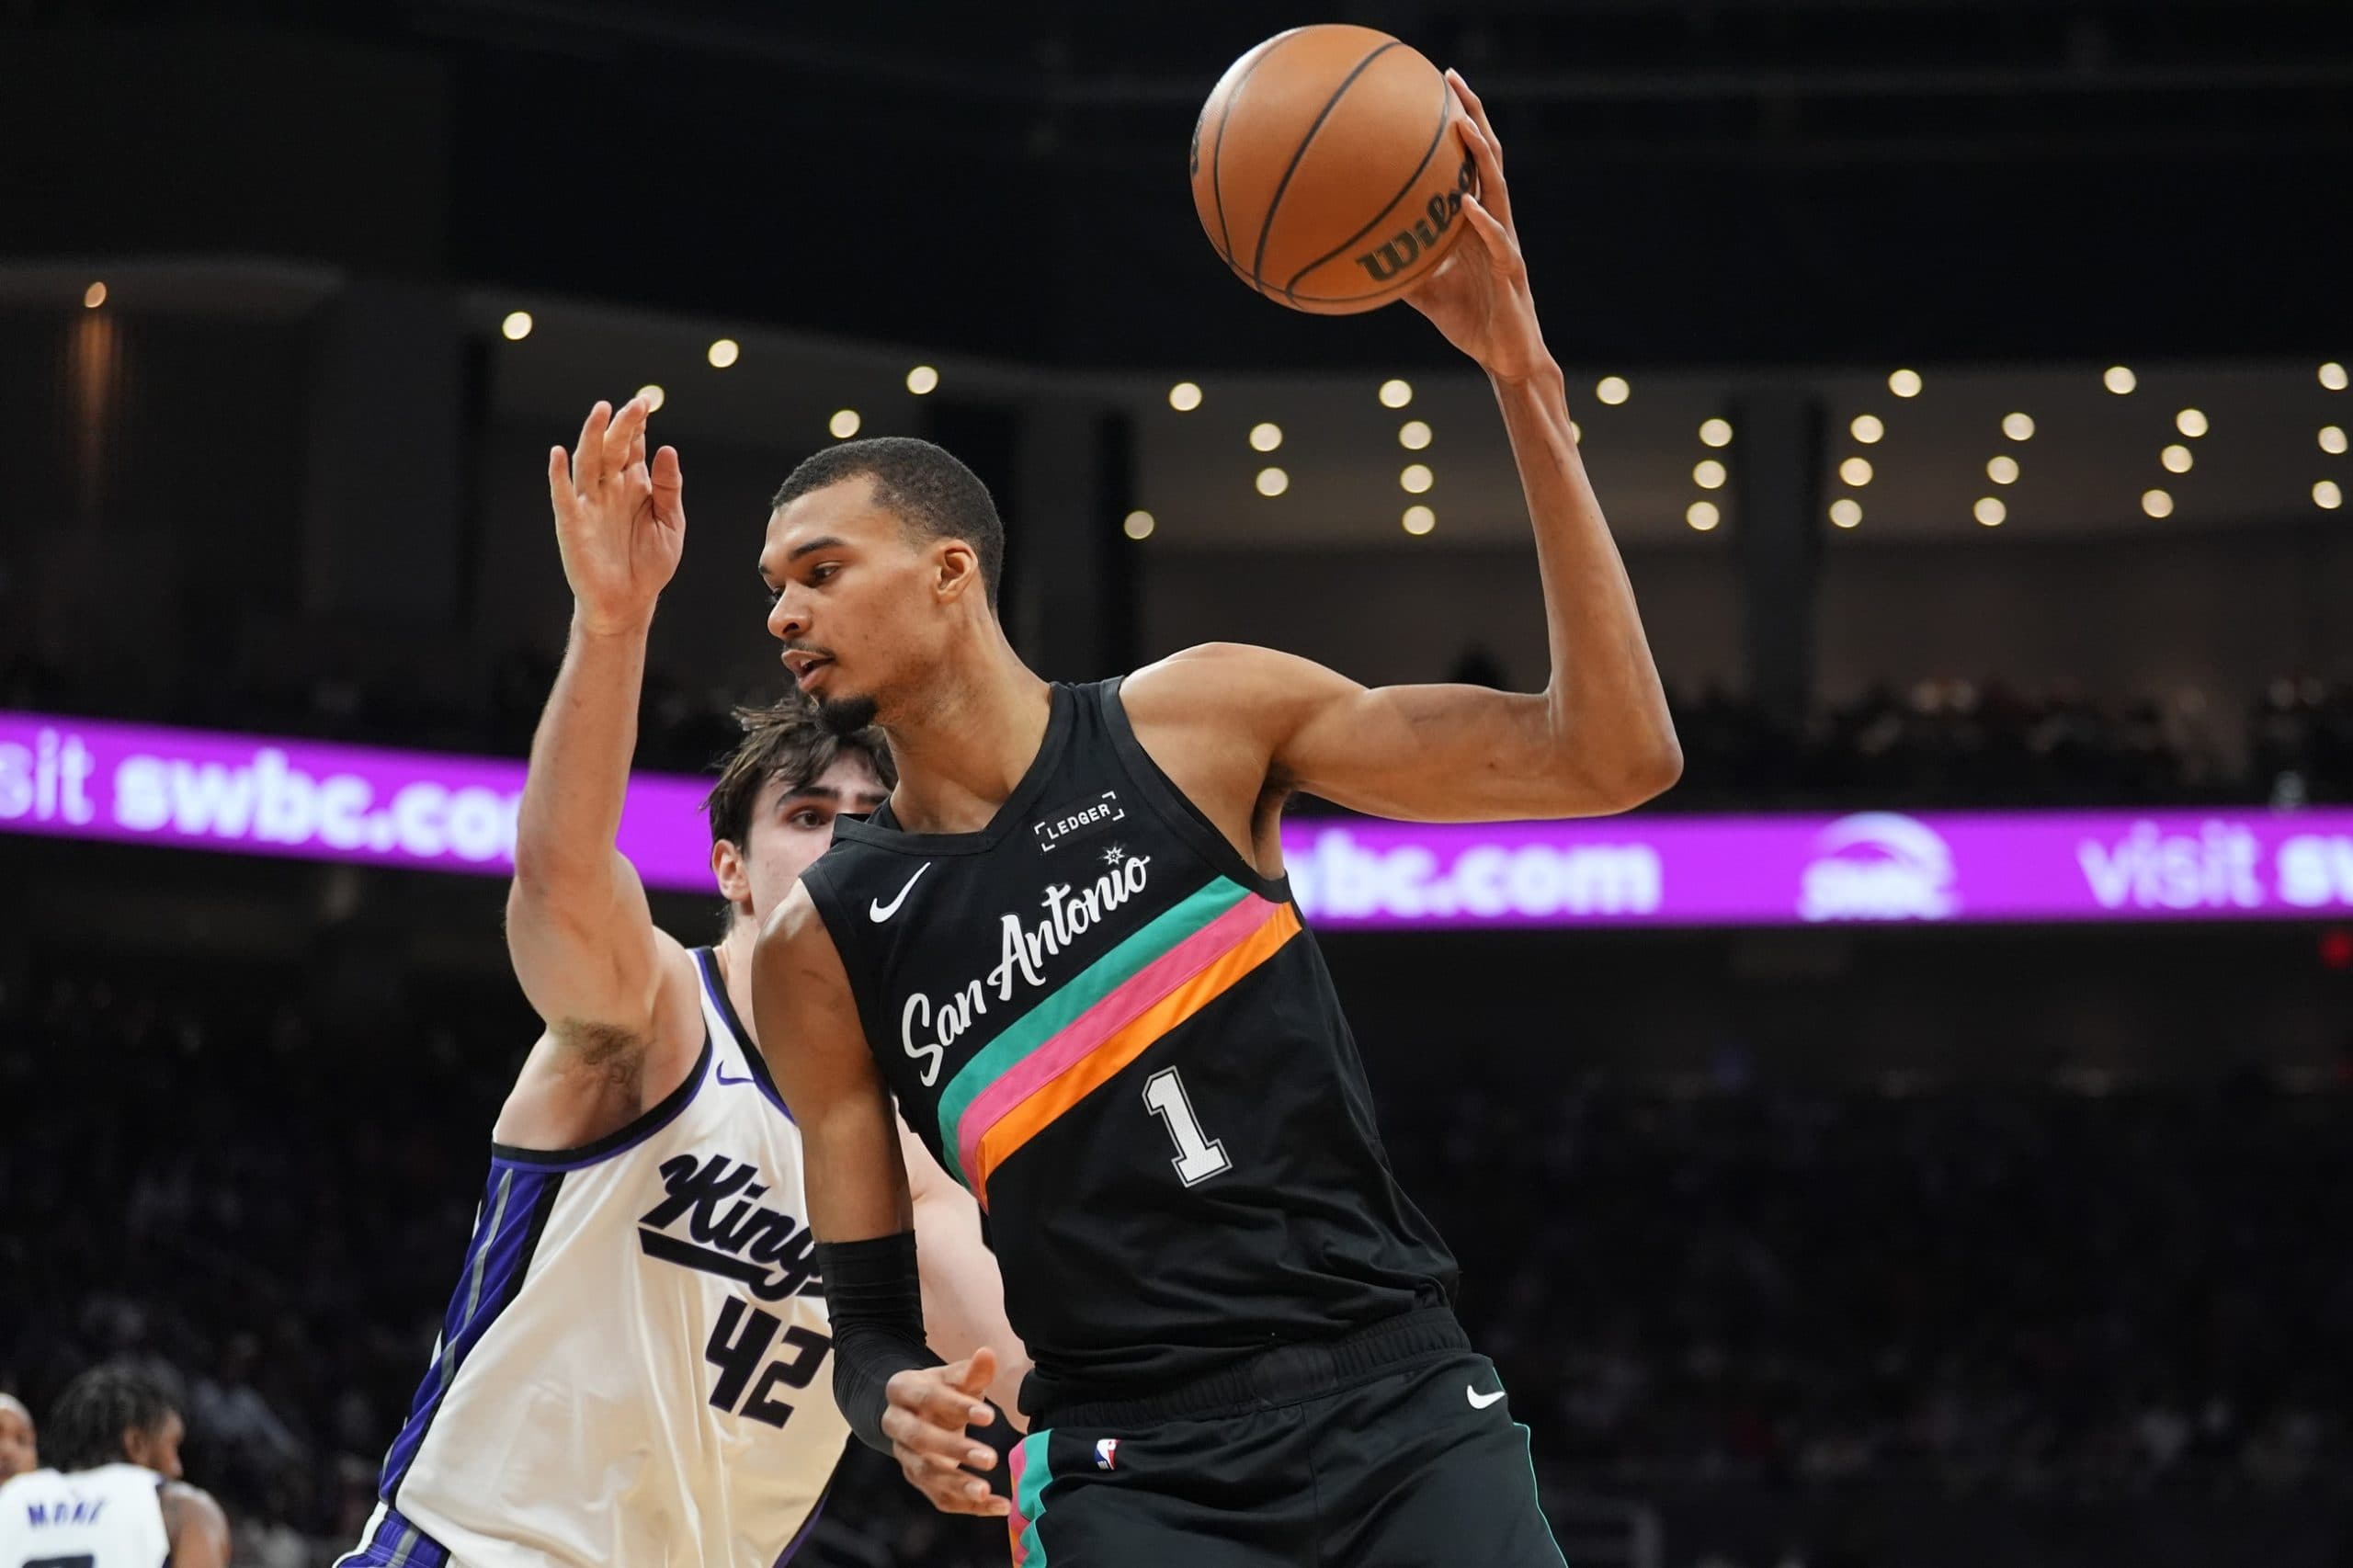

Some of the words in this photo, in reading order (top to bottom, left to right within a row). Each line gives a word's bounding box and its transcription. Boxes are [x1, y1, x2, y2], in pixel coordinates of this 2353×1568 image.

[1355, 150, 1477, 281] Wilso
[114, 748, 520, 862] swbc.co
[1046, 803, 1111, 840] LEDGER
[2075, 820, 2264, 908] visit
[901, 980, 987, 1087] San
[987, 854, 1151, 1001] Antonio
[1142, 1065, 1233, 1187] 1
[638, 1153, 824, 1301] King
[706, 1294, 835, 1429] 42
